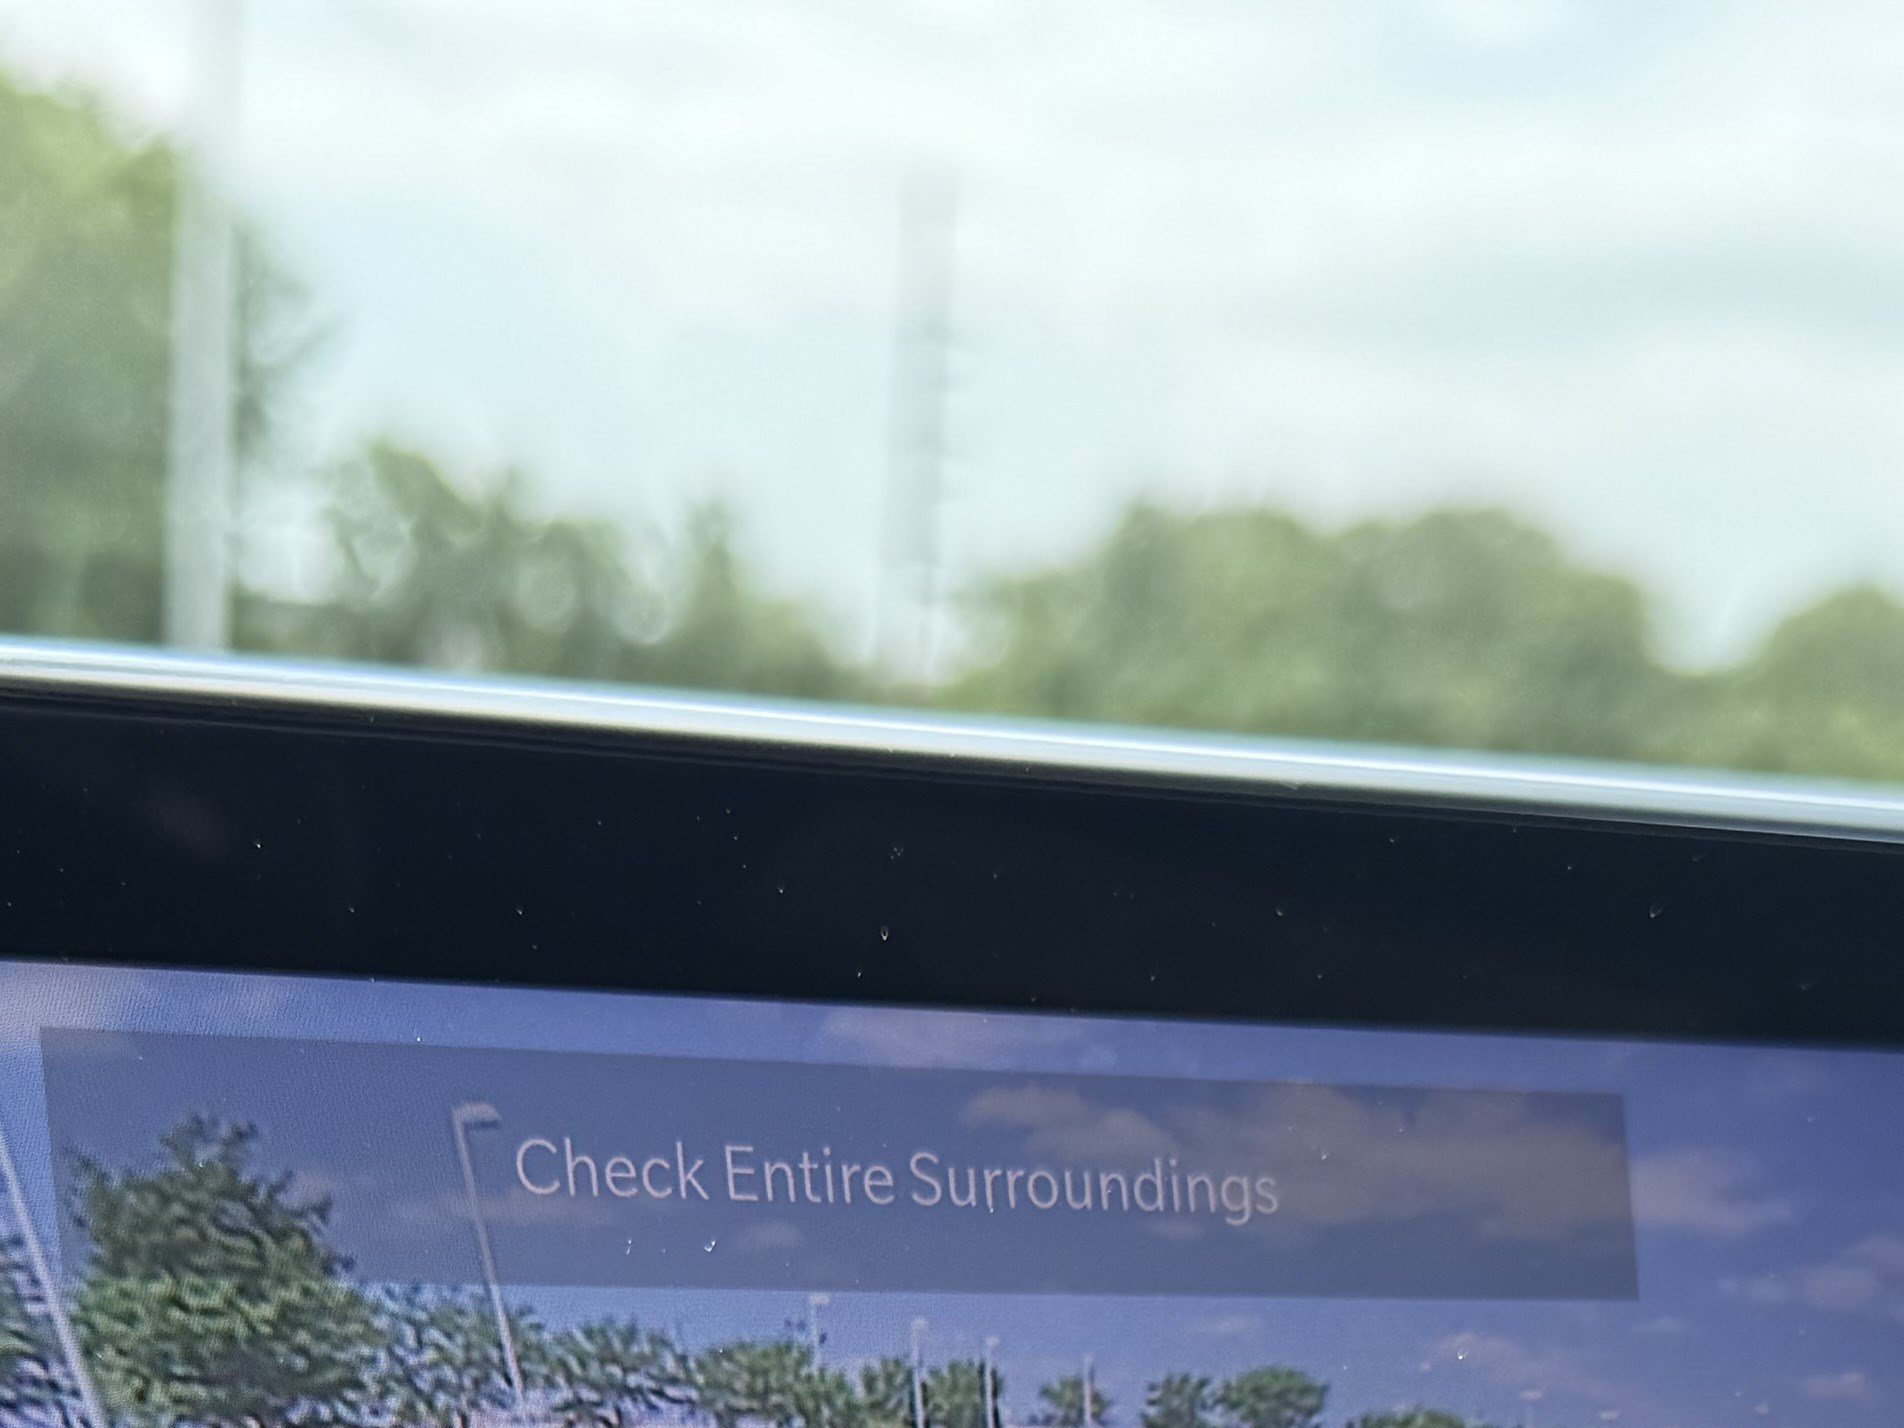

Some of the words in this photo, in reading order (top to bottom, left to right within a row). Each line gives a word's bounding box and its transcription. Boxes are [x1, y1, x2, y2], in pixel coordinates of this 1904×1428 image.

[514, 1136, 710, 1201] Check
[725, 1144, 895, 1206] Entire
[909, 1152, 1280, 1228] Surroundings
